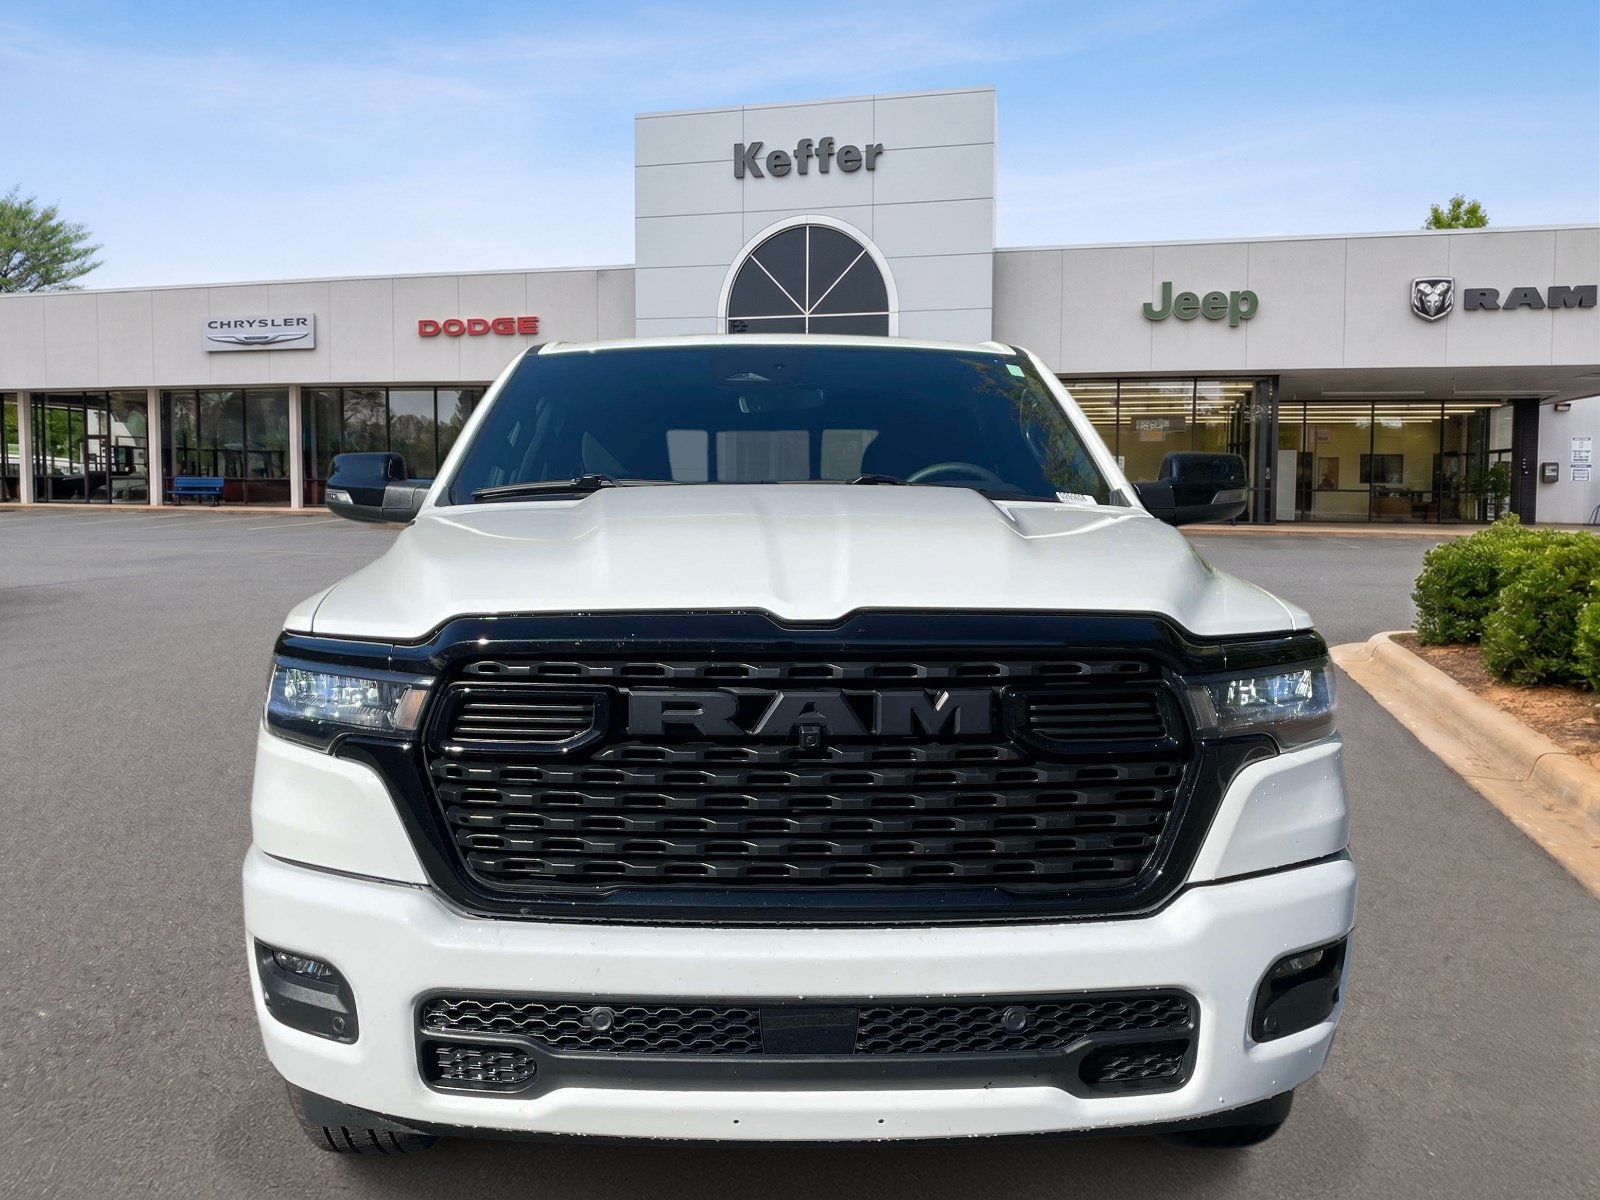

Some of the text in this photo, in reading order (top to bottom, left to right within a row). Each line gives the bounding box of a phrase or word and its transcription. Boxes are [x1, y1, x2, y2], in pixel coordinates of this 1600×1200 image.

[733, 136, 884, 179] Keffer
[1142, 281, 1259, 327] Jeep
[1464, 285, 1598, 311] RAM
[207, 317, 308, 330] CHRYSLER
[418, 316, 539, 337] DODGE
[627, 686, 994, 736] RAM
